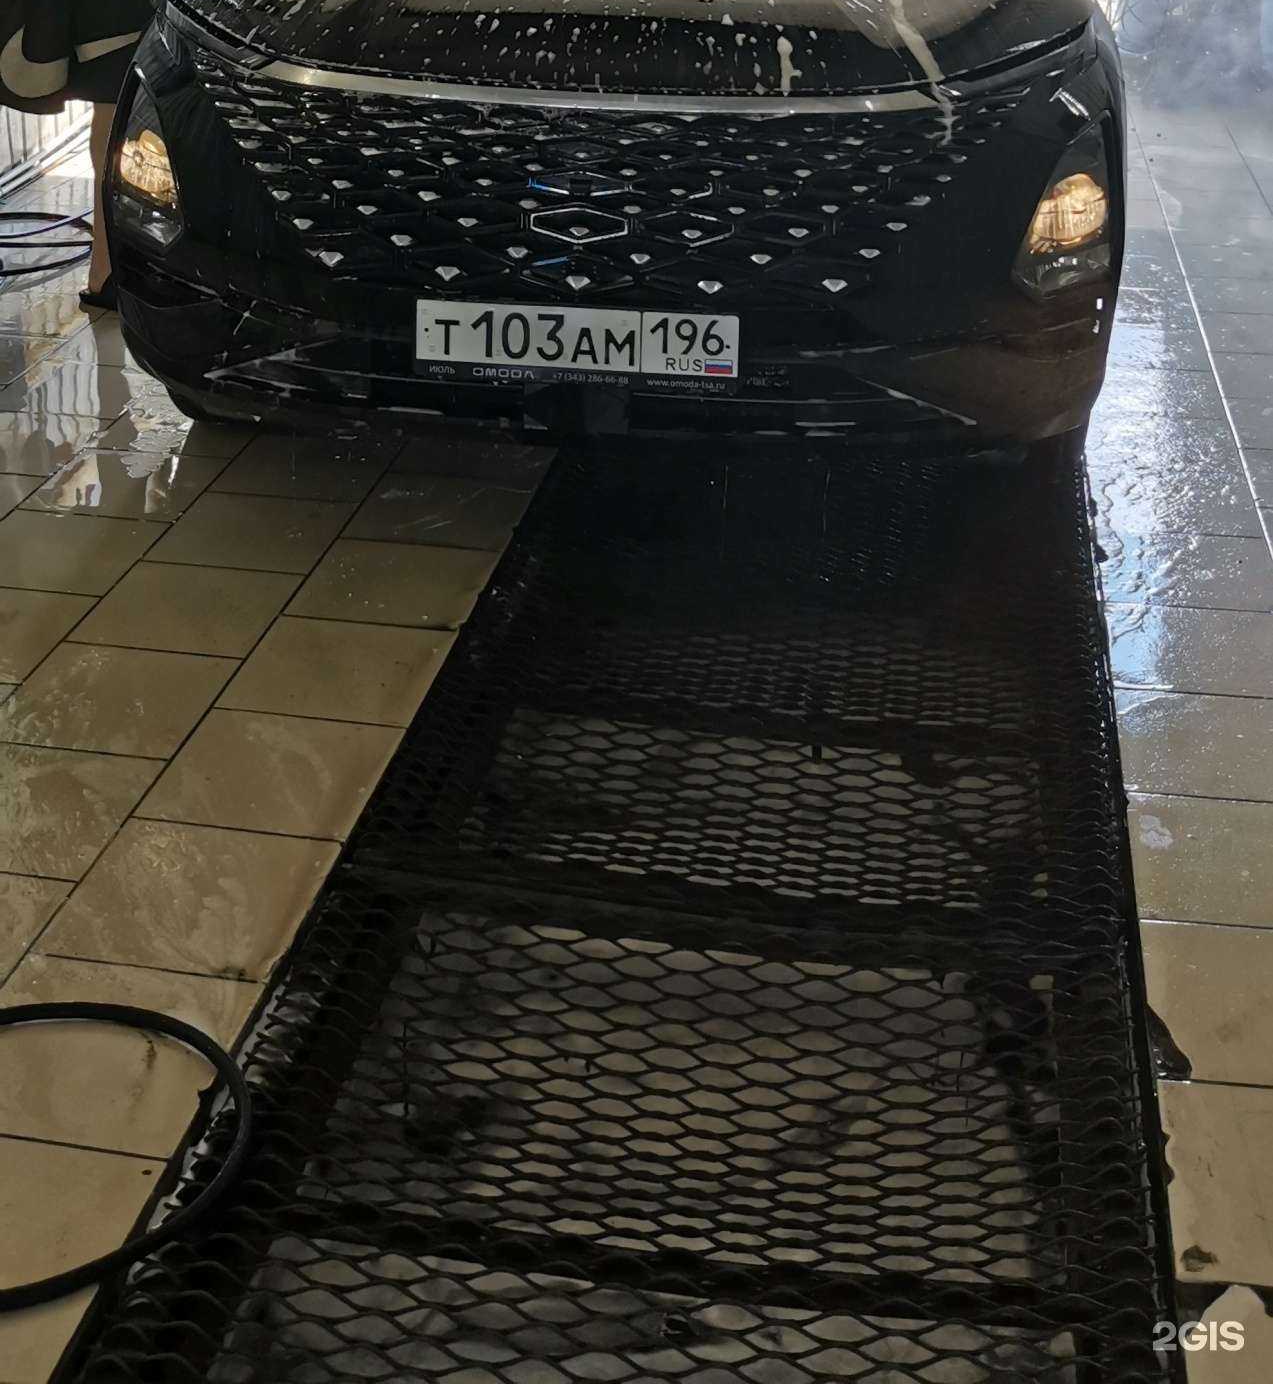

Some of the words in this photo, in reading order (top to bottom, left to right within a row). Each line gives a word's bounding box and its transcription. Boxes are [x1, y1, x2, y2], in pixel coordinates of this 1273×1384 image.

[649, 317, 722, 356] 196
[665, 357, 702, 372] RUS
[472, 367, 535, 380] OMODA
